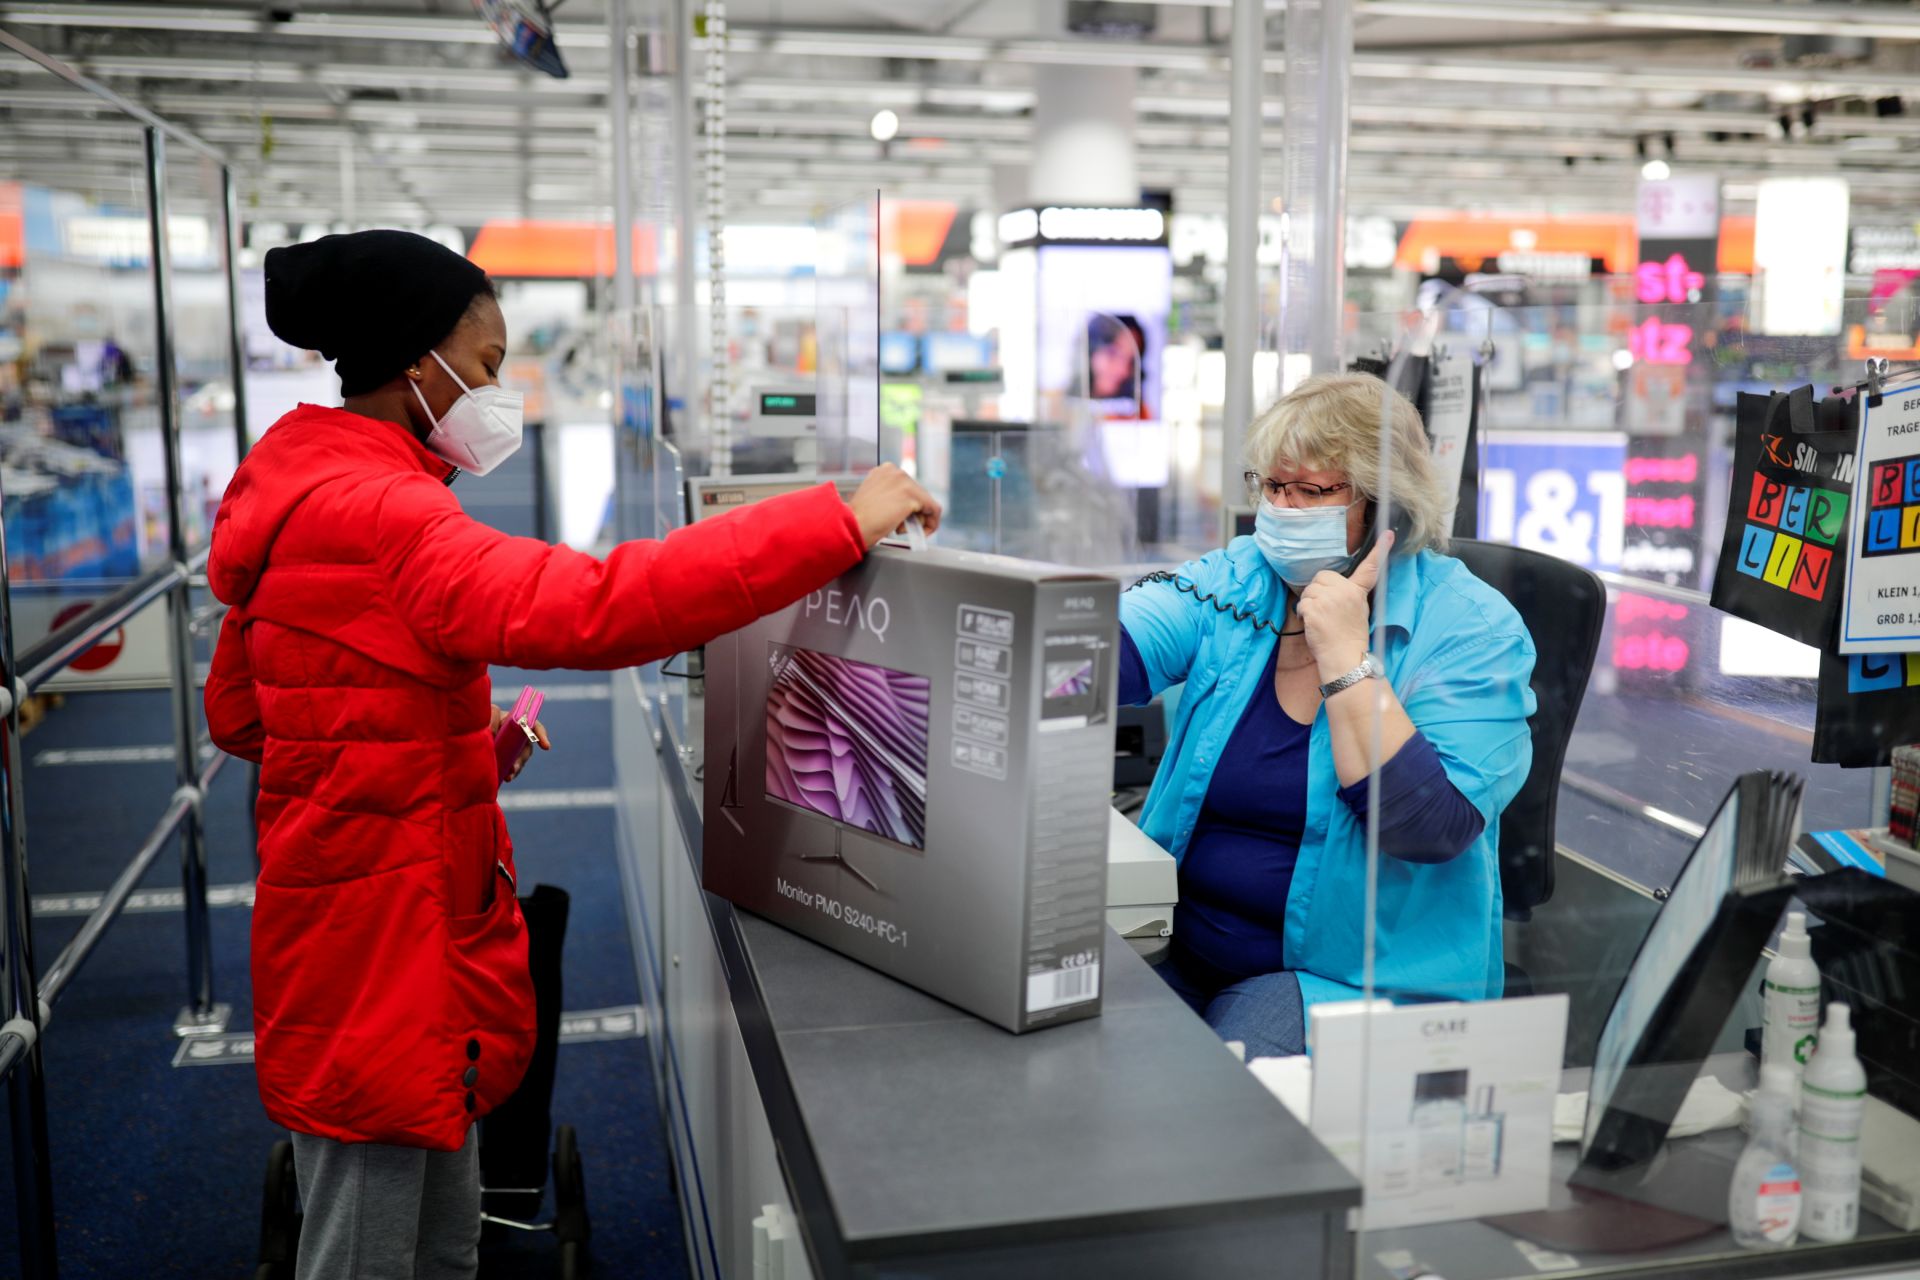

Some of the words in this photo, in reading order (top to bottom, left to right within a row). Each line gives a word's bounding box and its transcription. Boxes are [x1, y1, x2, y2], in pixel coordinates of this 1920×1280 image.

[1482, 468, 1626, 566] 1&1
[805, 588, 890, 643] PEAQ
[1877, 586, 1909, 598] KLEIN
[777, 877, 813, 906] Monitor
[815, 894, 841, 919] PMO
